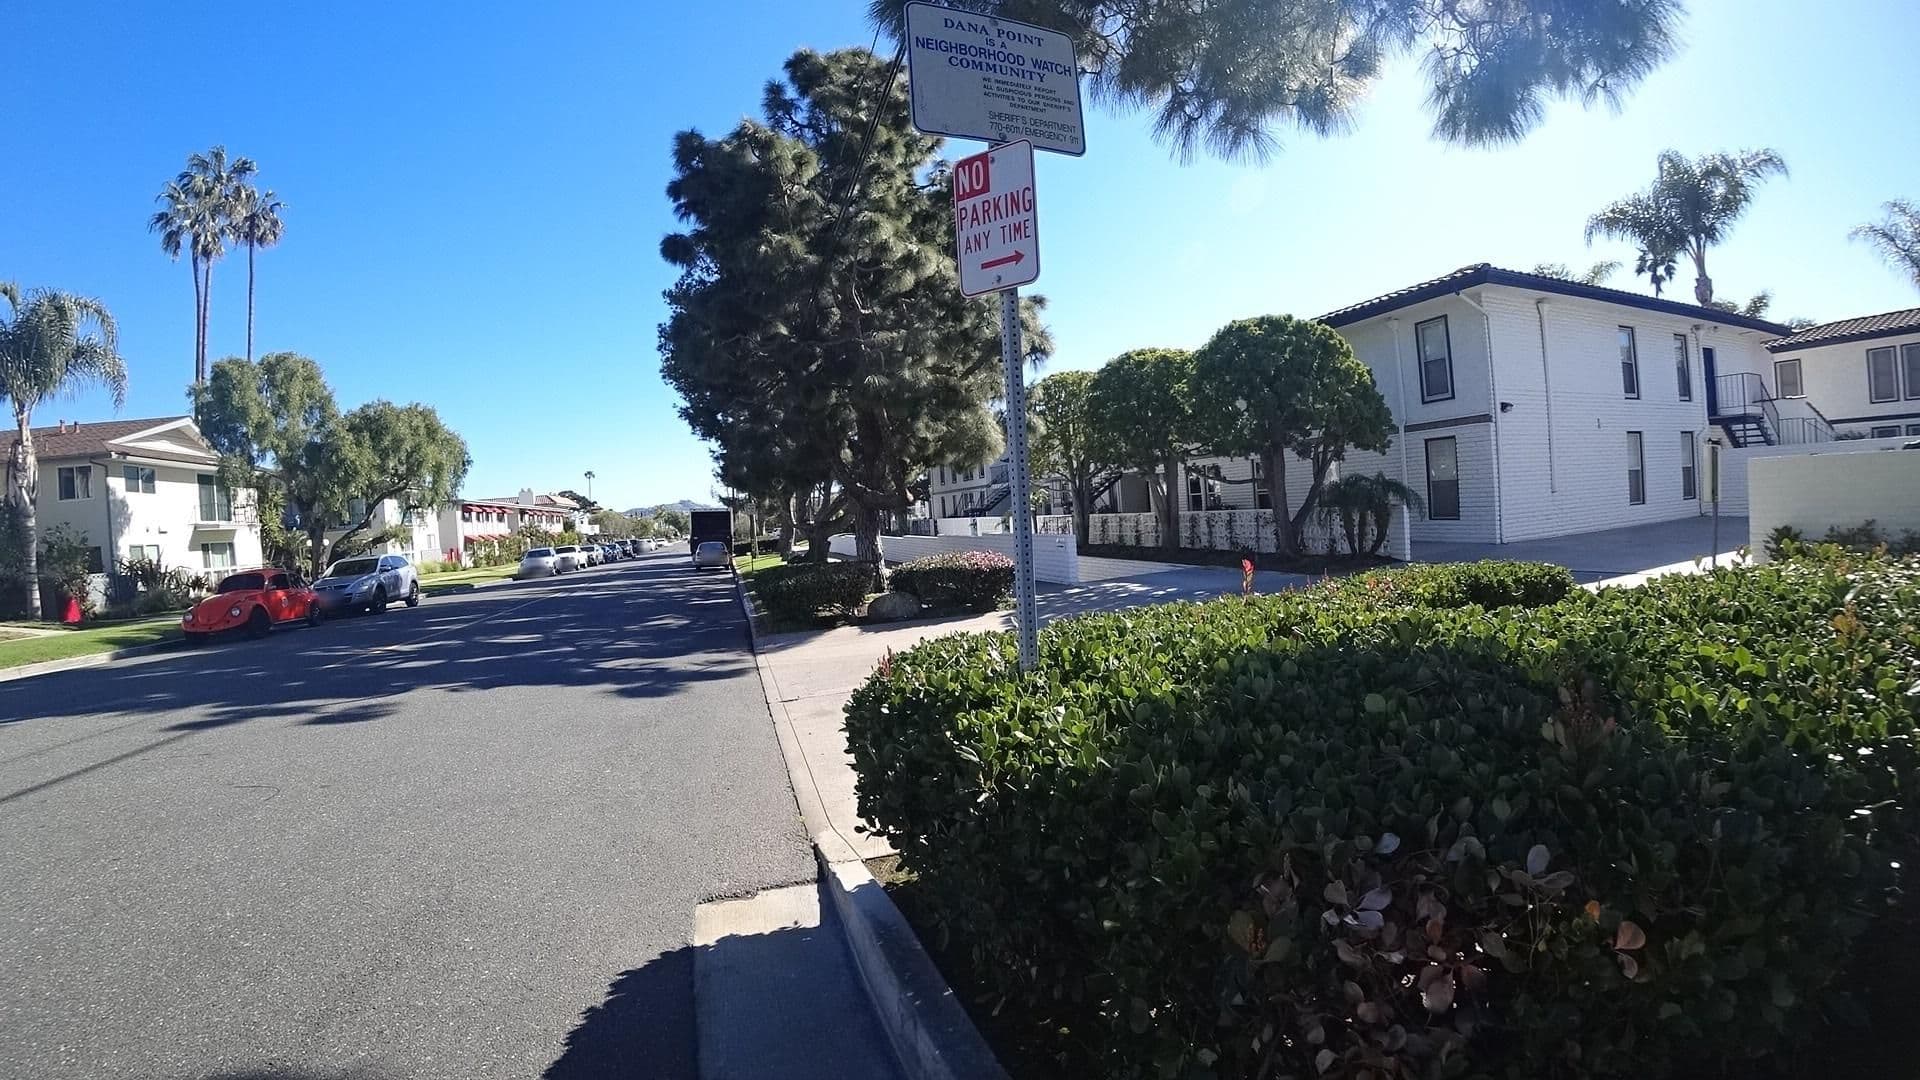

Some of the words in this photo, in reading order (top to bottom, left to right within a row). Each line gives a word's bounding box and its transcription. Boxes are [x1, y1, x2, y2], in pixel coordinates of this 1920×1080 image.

[944, 18, 989, 35] DANA
[997, 29, 1044, 47] POINT
[986, 37, 995, 46] IS
[916, 36, 1025, 66] NEIGHBORHOOD
[1031, 58, 1072, 77] WATCH
[949, 56, 1046, 82] COMMUNITY
[1010, 102, 1047, 113] DEPARTMENT
[1030, 118, 1076, 133] DEPARTMENT
[1070, 135, 1078, 144] 911
[958, 160, 984, 195] NO
[959, 186, 1032, 231] PARKING
[964, 230, 991, 255] ANY
[1000, 219, 1031, 244] TIME
